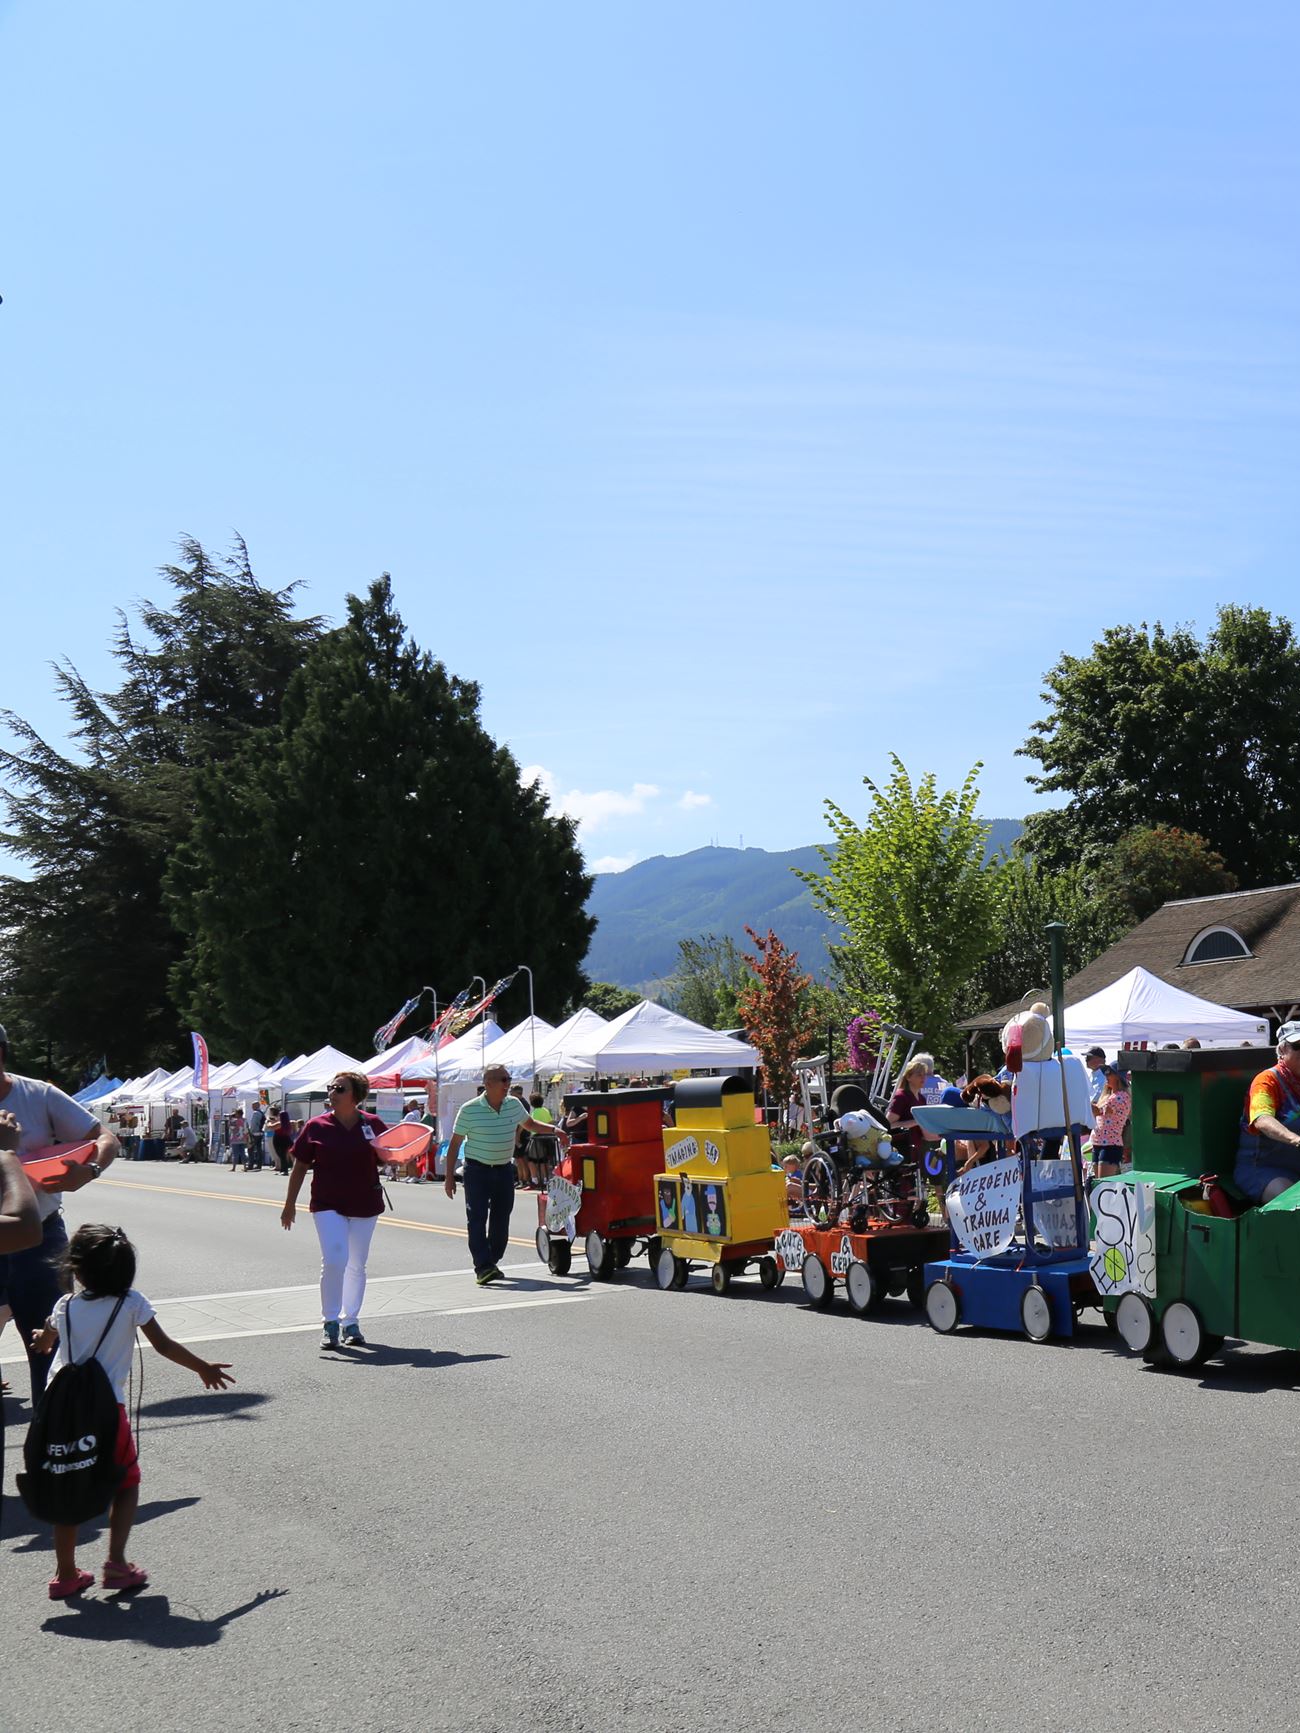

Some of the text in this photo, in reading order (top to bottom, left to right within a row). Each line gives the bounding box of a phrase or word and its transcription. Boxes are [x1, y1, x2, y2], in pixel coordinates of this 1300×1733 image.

[949, 1167, 1020, 1196] EMERGENC
[974, 1192, 987, 1212] &
[963, 1207, 1010, 1233] TRAUMA
[775, 1233, 803, 1253] ACUTE
[842, 1236, 850, 1255] &
[973, 1230, 1000, 1252] CARE
